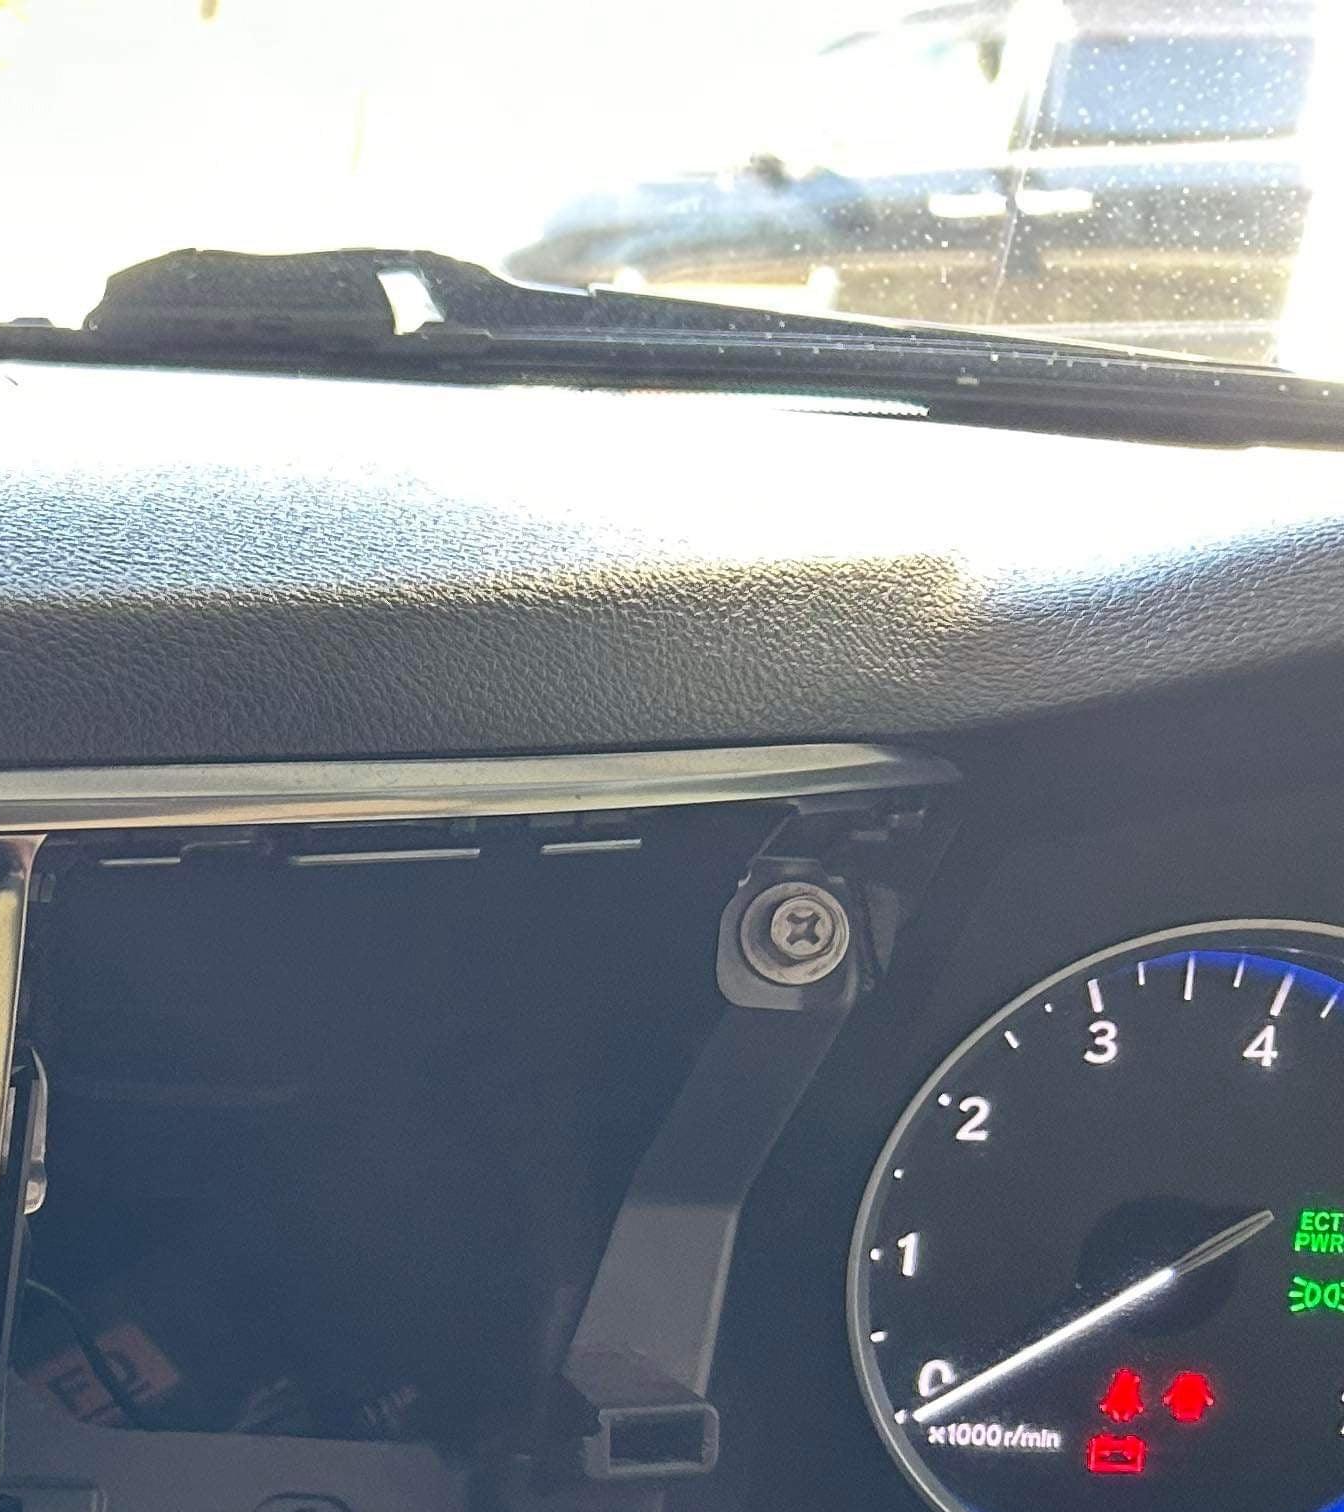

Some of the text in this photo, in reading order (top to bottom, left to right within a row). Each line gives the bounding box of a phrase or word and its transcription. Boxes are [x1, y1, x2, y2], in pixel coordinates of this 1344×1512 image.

[1084, 1021, 1118, 1064] 3
[1243, 1025, 1278, 1068] 4
[955, 1097, 991, 1141] 2
[1294, 1231, 1344, 1252] PWR
[1300, 1211, 1344, 1232] ECT
[897, 1231, 921, 1277] 1
